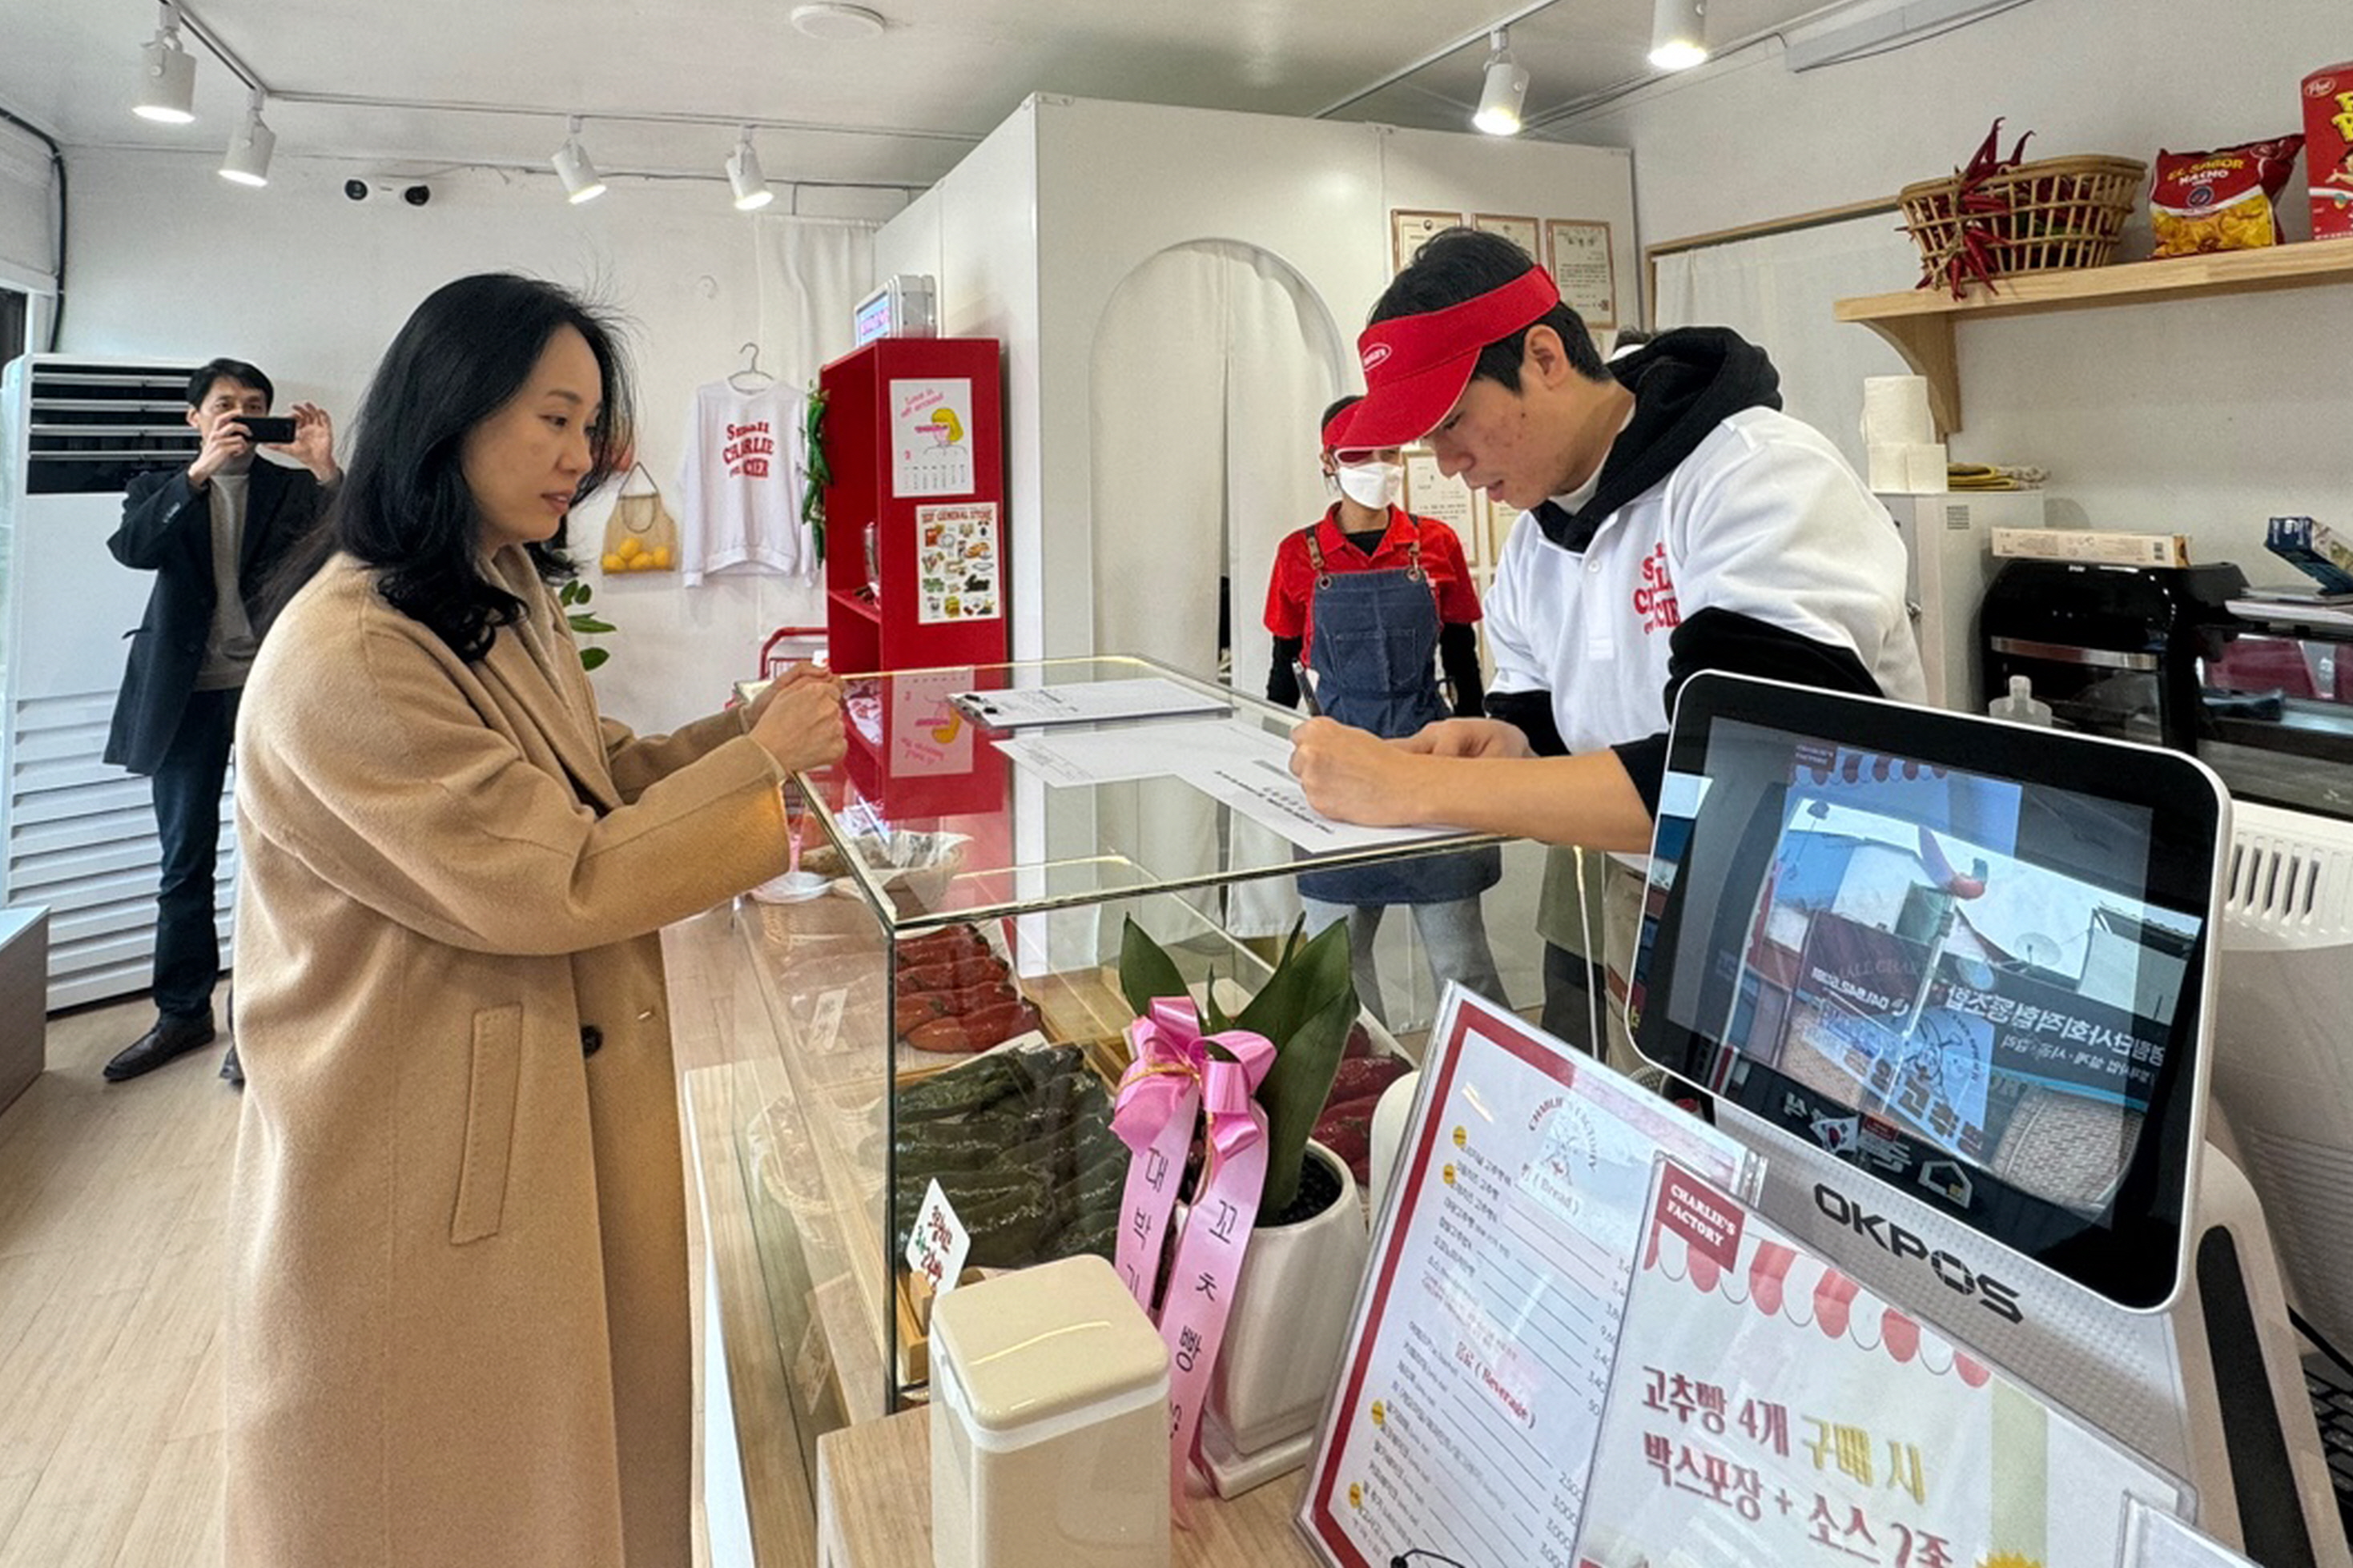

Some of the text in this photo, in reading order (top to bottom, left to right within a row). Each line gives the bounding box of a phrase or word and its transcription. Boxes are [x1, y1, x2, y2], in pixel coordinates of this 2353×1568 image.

[1667, 1198, 1725, 1248] FACTORY
[1670, 1184, 1736, 1236] CHARLIE'S
[1813, 1186, 2025, 1325] OKPOS
[1642, 1365, 1728, 1435] 고추빵
[1738, 1397, 1791, 1458] 4개
[1886, 1440, 1926, 1506] 시
[1643, 1430, 1764, 1522] 박스포장
[1808, 1492, 1881, 1566] 소스
